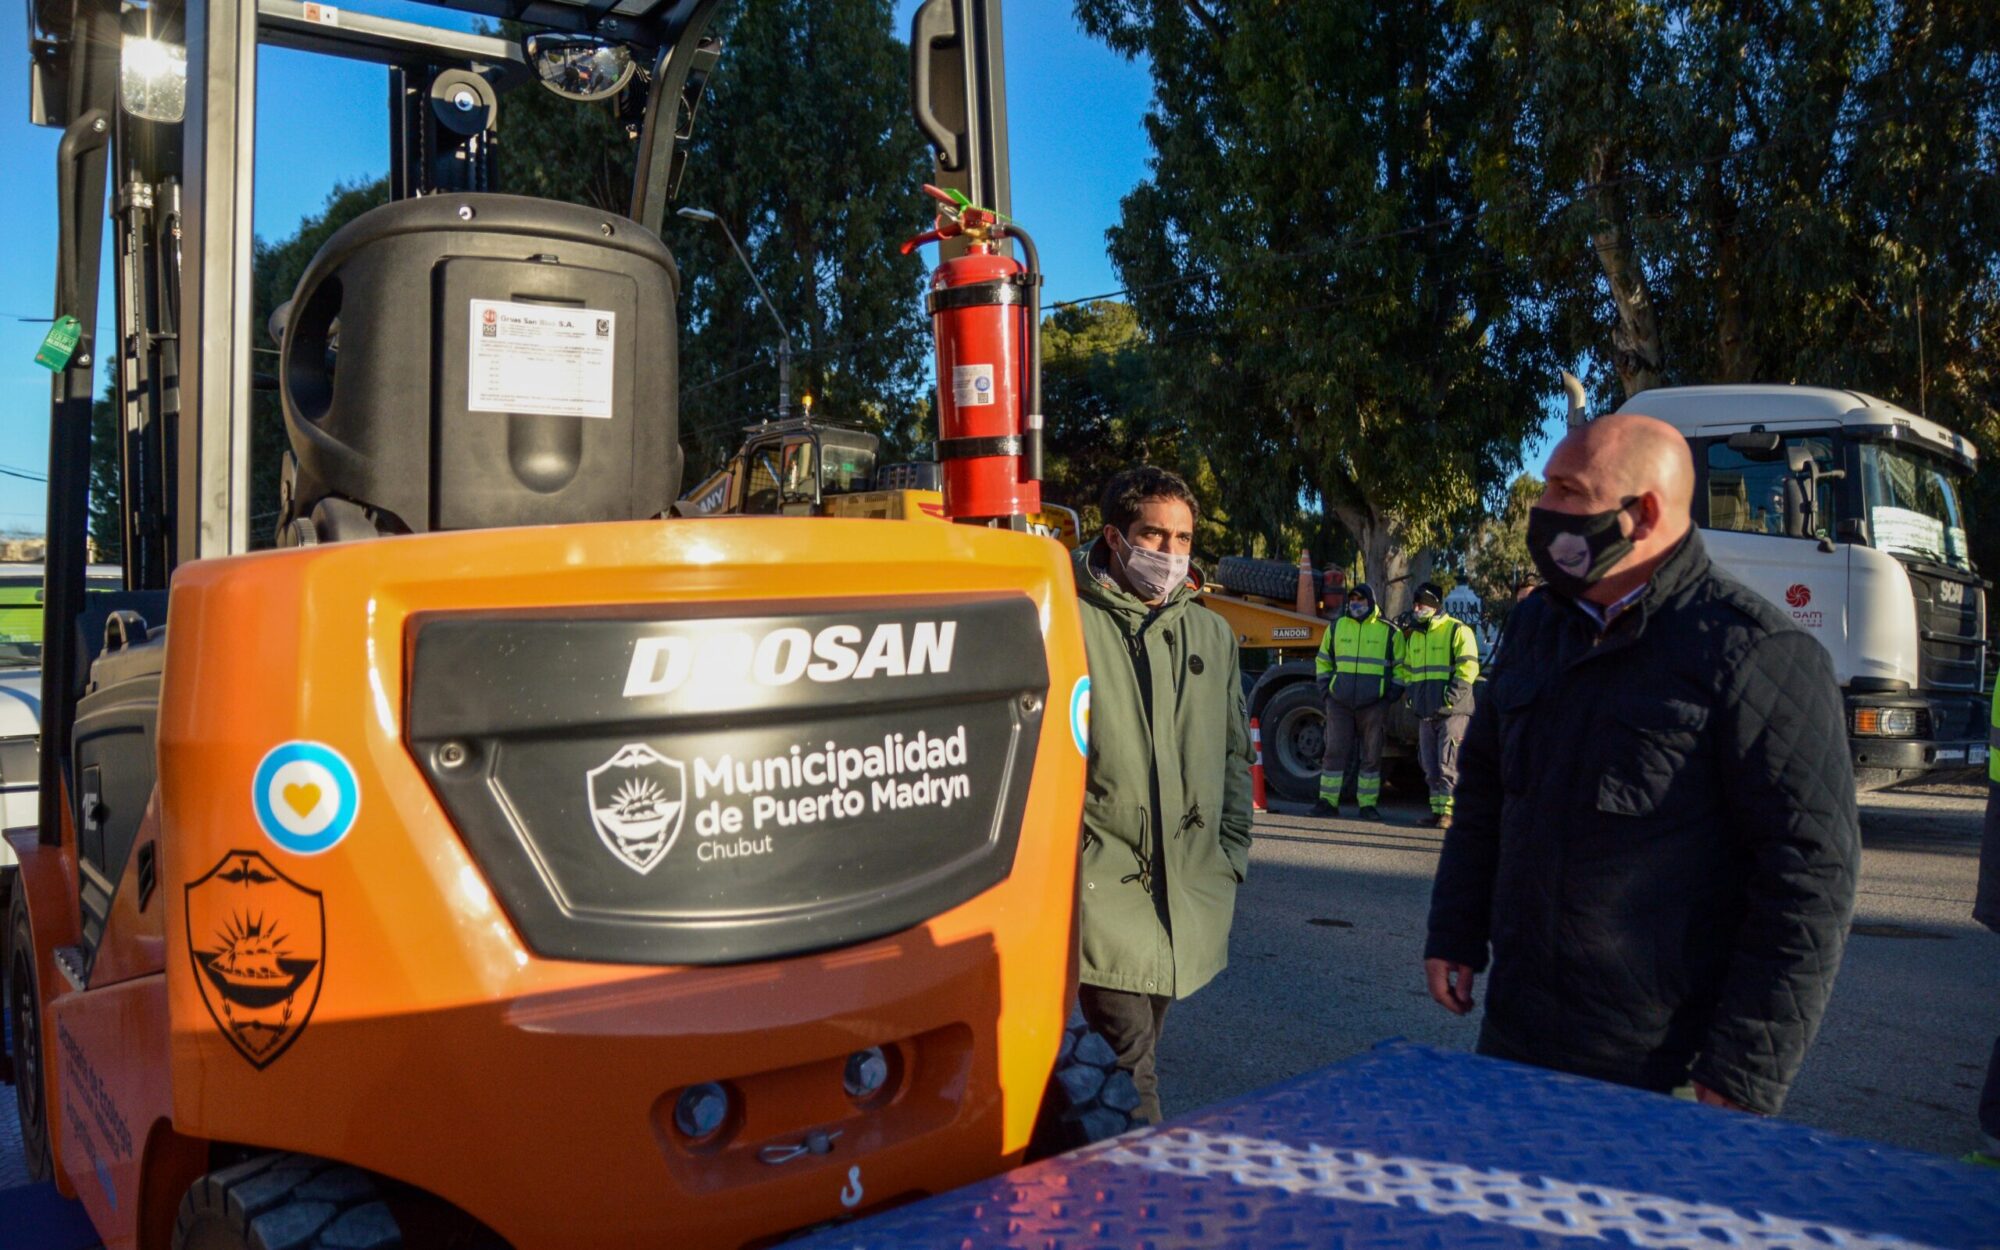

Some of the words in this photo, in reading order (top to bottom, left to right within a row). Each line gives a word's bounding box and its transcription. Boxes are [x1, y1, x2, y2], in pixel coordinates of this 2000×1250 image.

[700, 487, 724, 512] ANY
[1273, 628, 1307, 638] RANDON
[693, 725, 967, 799] Municipalidad
[694, 800, 744, 837] de
[752, 787, 866, 830] Puerto
[871, 772, 971, 813] Madryn
[696, 834, 774, 863] Chubut
